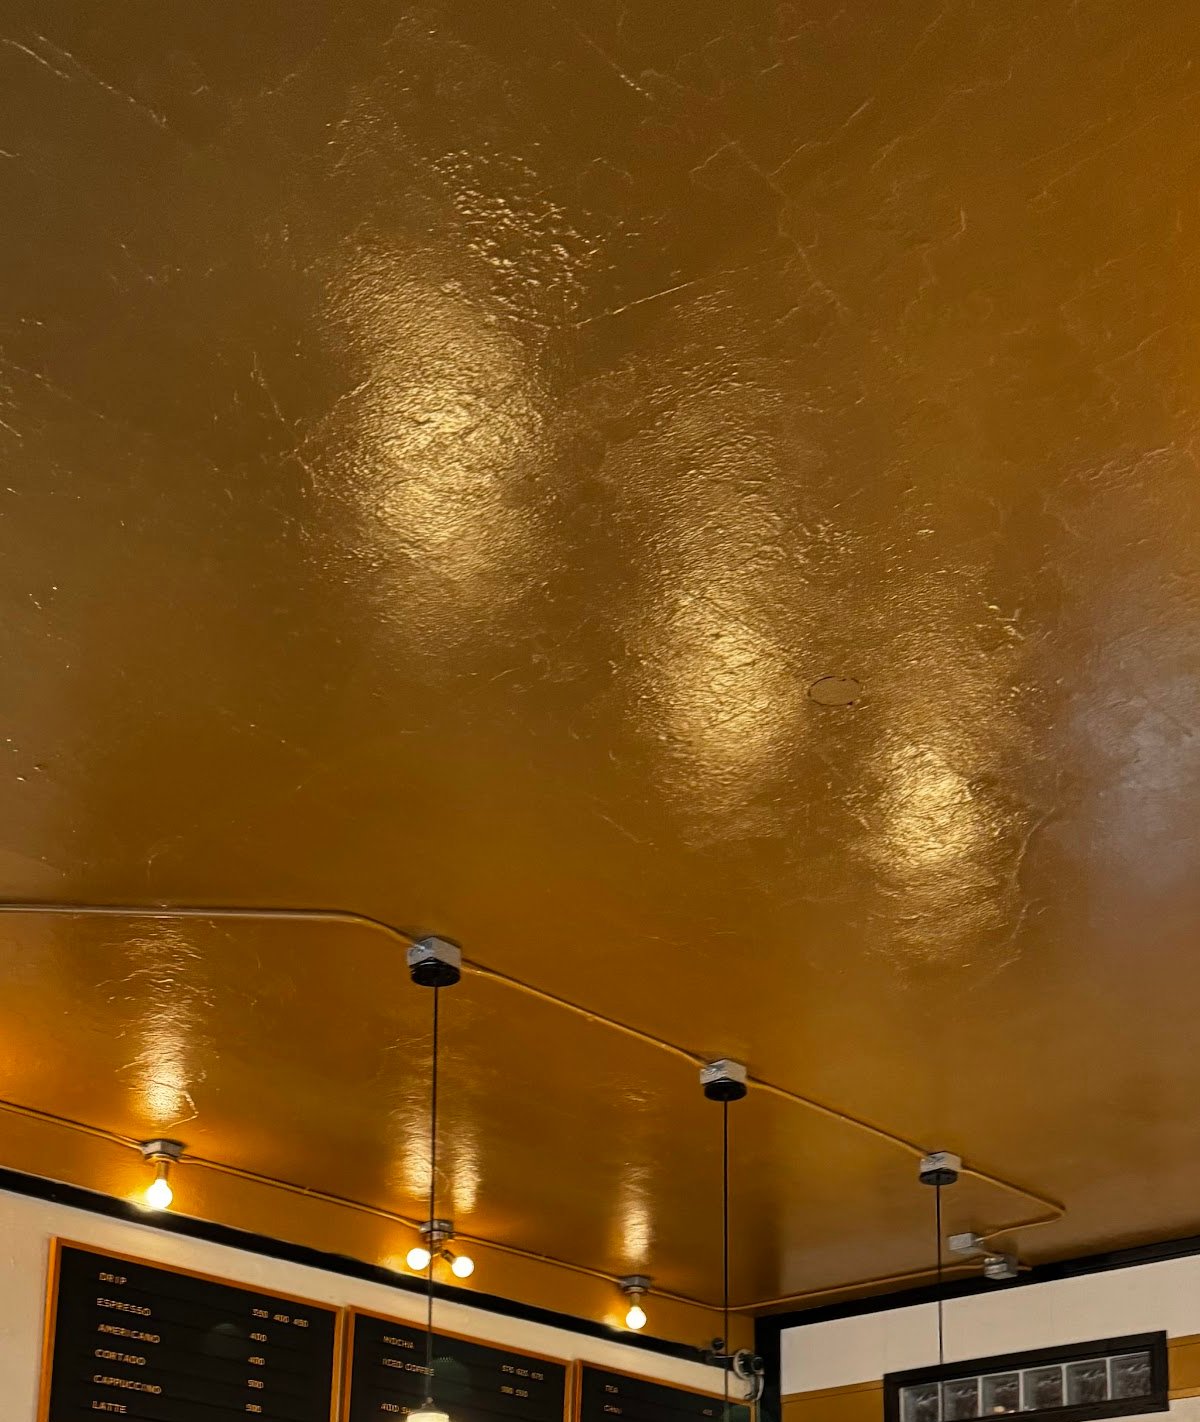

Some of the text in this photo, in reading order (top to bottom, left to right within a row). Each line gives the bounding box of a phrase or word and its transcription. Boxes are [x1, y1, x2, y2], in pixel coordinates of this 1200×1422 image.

[99, 1272, 127, 1284] DRIP
[97, 1298, 151, 1316] ESPRESSO
[98, 1324, 160, 1343] AMERICANO
[95, 1349, 145, 1365] CORTADO
[94, 1375, 161, 1394] CAPPUCCINO
[92, 1401, 126, 1413] LATTE
